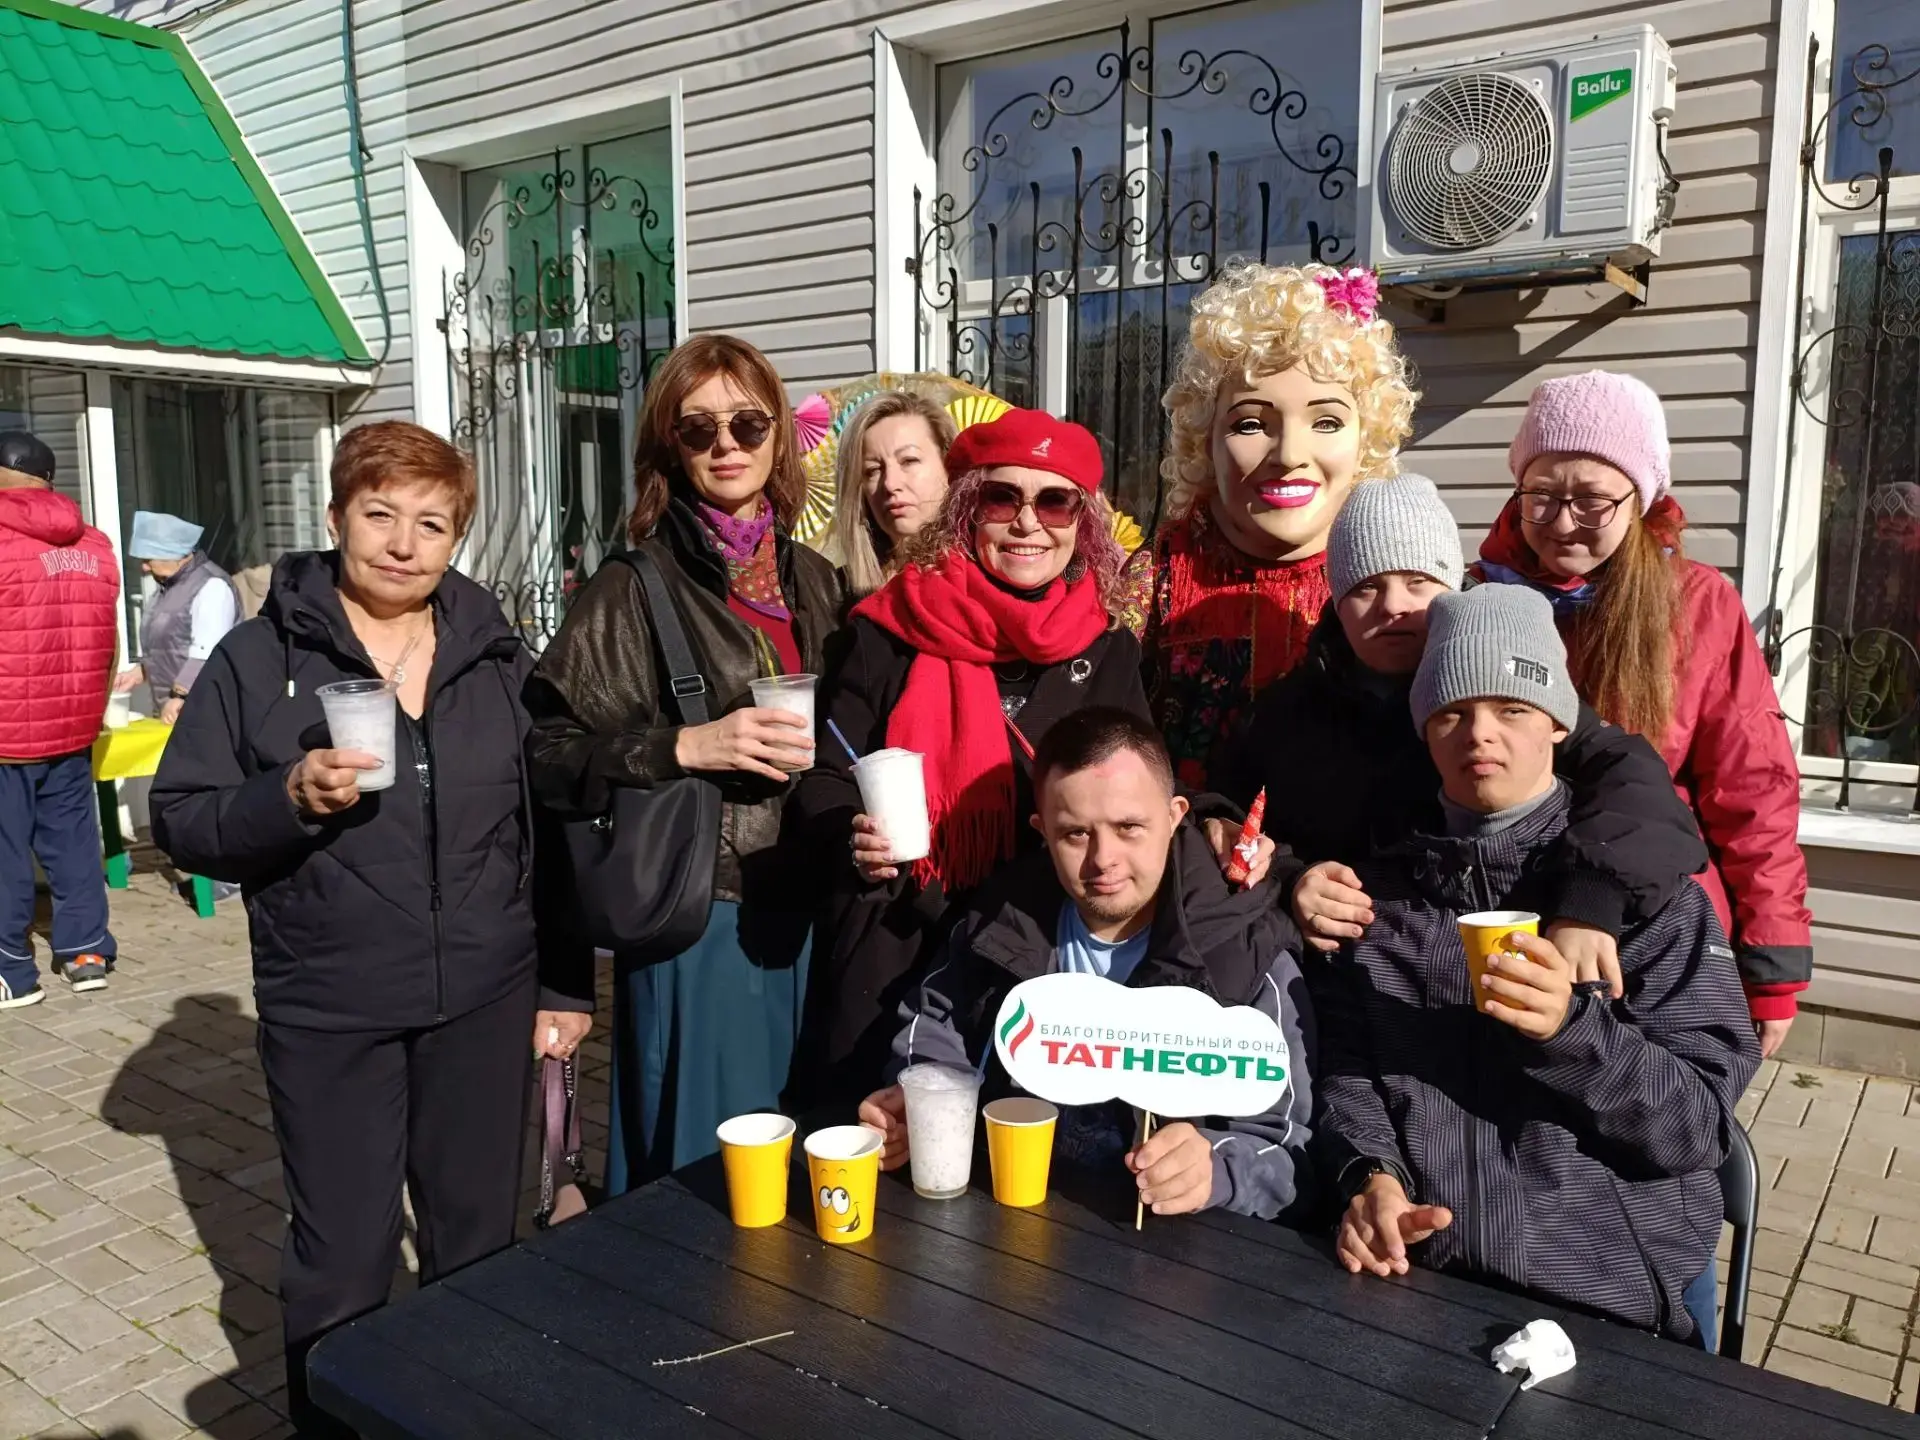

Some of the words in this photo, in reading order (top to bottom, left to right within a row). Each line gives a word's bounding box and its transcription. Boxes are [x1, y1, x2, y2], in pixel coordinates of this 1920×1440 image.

[1577, 74, 1621, 96] Ballu
[40, 548, 98, 577] RUSSIA
[1040, 1023, 1232, 1049] БЛАГОТВОРИТЕЛЬНЫЙ
[1237, 1039, 1287, 1055] ФОНД
[1040, 1040, 1286, 1082] ТАТНЕФТЬ
